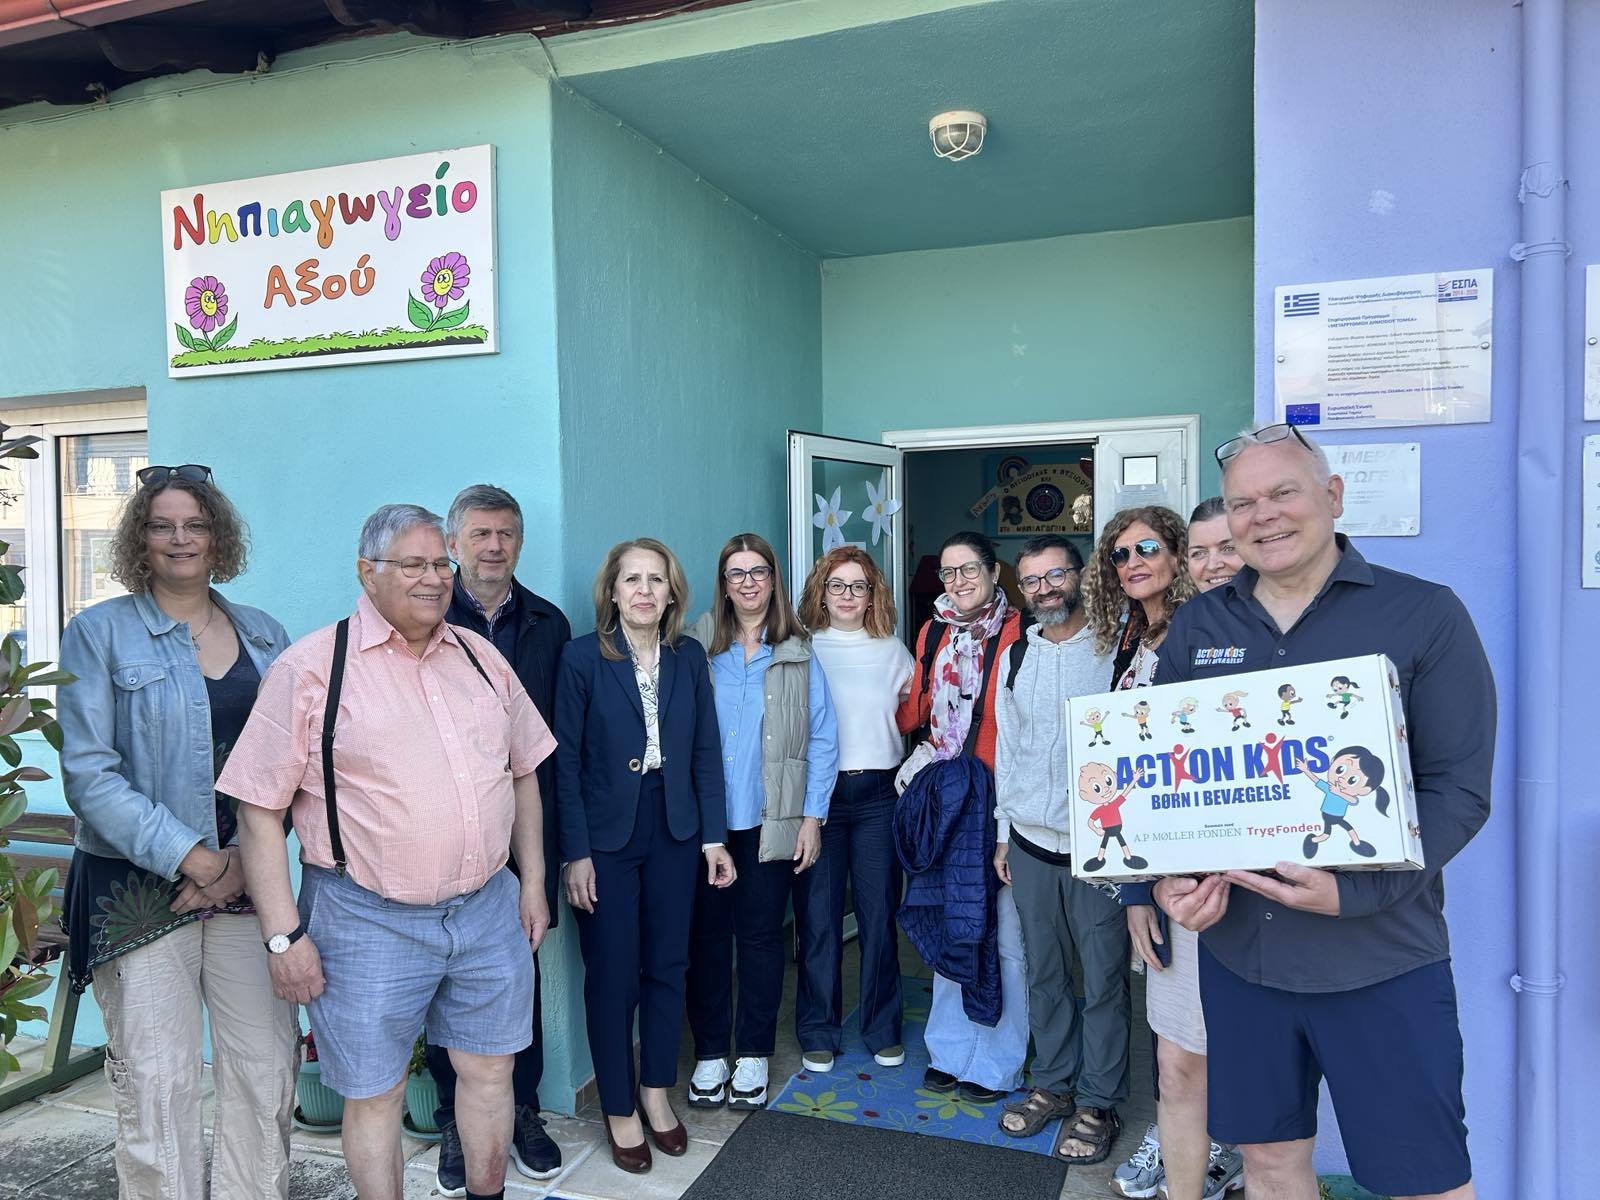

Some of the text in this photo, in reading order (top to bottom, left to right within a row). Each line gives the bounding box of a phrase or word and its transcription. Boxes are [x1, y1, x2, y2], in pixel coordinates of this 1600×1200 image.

[173, 161, 477, 250] Νηπιαγωγείο
[263, 254, 376, 309] Αξού
[1452, 278, 1478, 289] ΕΣΠΑ
[1196, 646, 1246, 659] ACTION KIDS
[1116, 744, 1234, 793] ACTION
[1151, 784, 1291, 810] BØRN I BEVÆGELSE
[1152, 830, 1195, 841] MØLLER
[1198, 827, 1242, 839] FONDEN
[1247, 823, 1322, 838] TrygFonden
